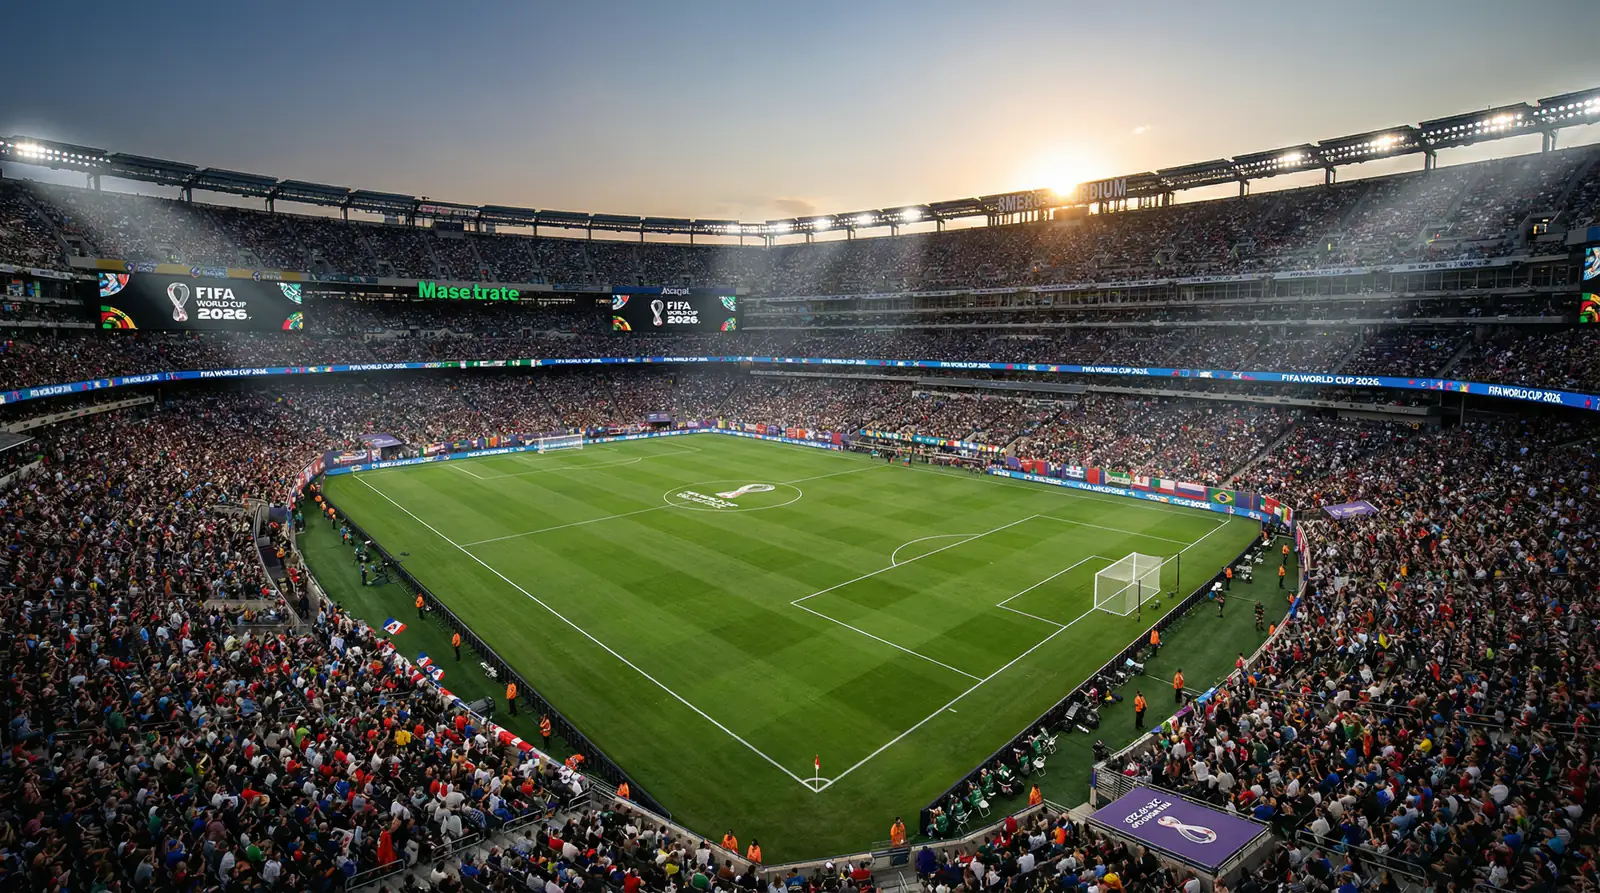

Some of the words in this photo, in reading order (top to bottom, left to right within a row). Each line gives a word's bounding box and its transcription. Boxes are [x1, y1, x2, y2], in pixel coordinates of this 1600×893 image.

[196, 287, 235, 300] FIFA
[196, 300, 228, 308] WORLD
[667, 302, 691, 310] FIFA
[1282, 374, 1300, 382] FIFA
[1300, 375, 1333, 383] WORLD
[1336, 376, 1354, 384] CUP
[1356, 377, 1381, 386] 2026.
[1488, 386, 1502, 396] FIFA
[1503, 388, 1527, 398] WORLD
[1528, 390, 1542, 400] CUP
